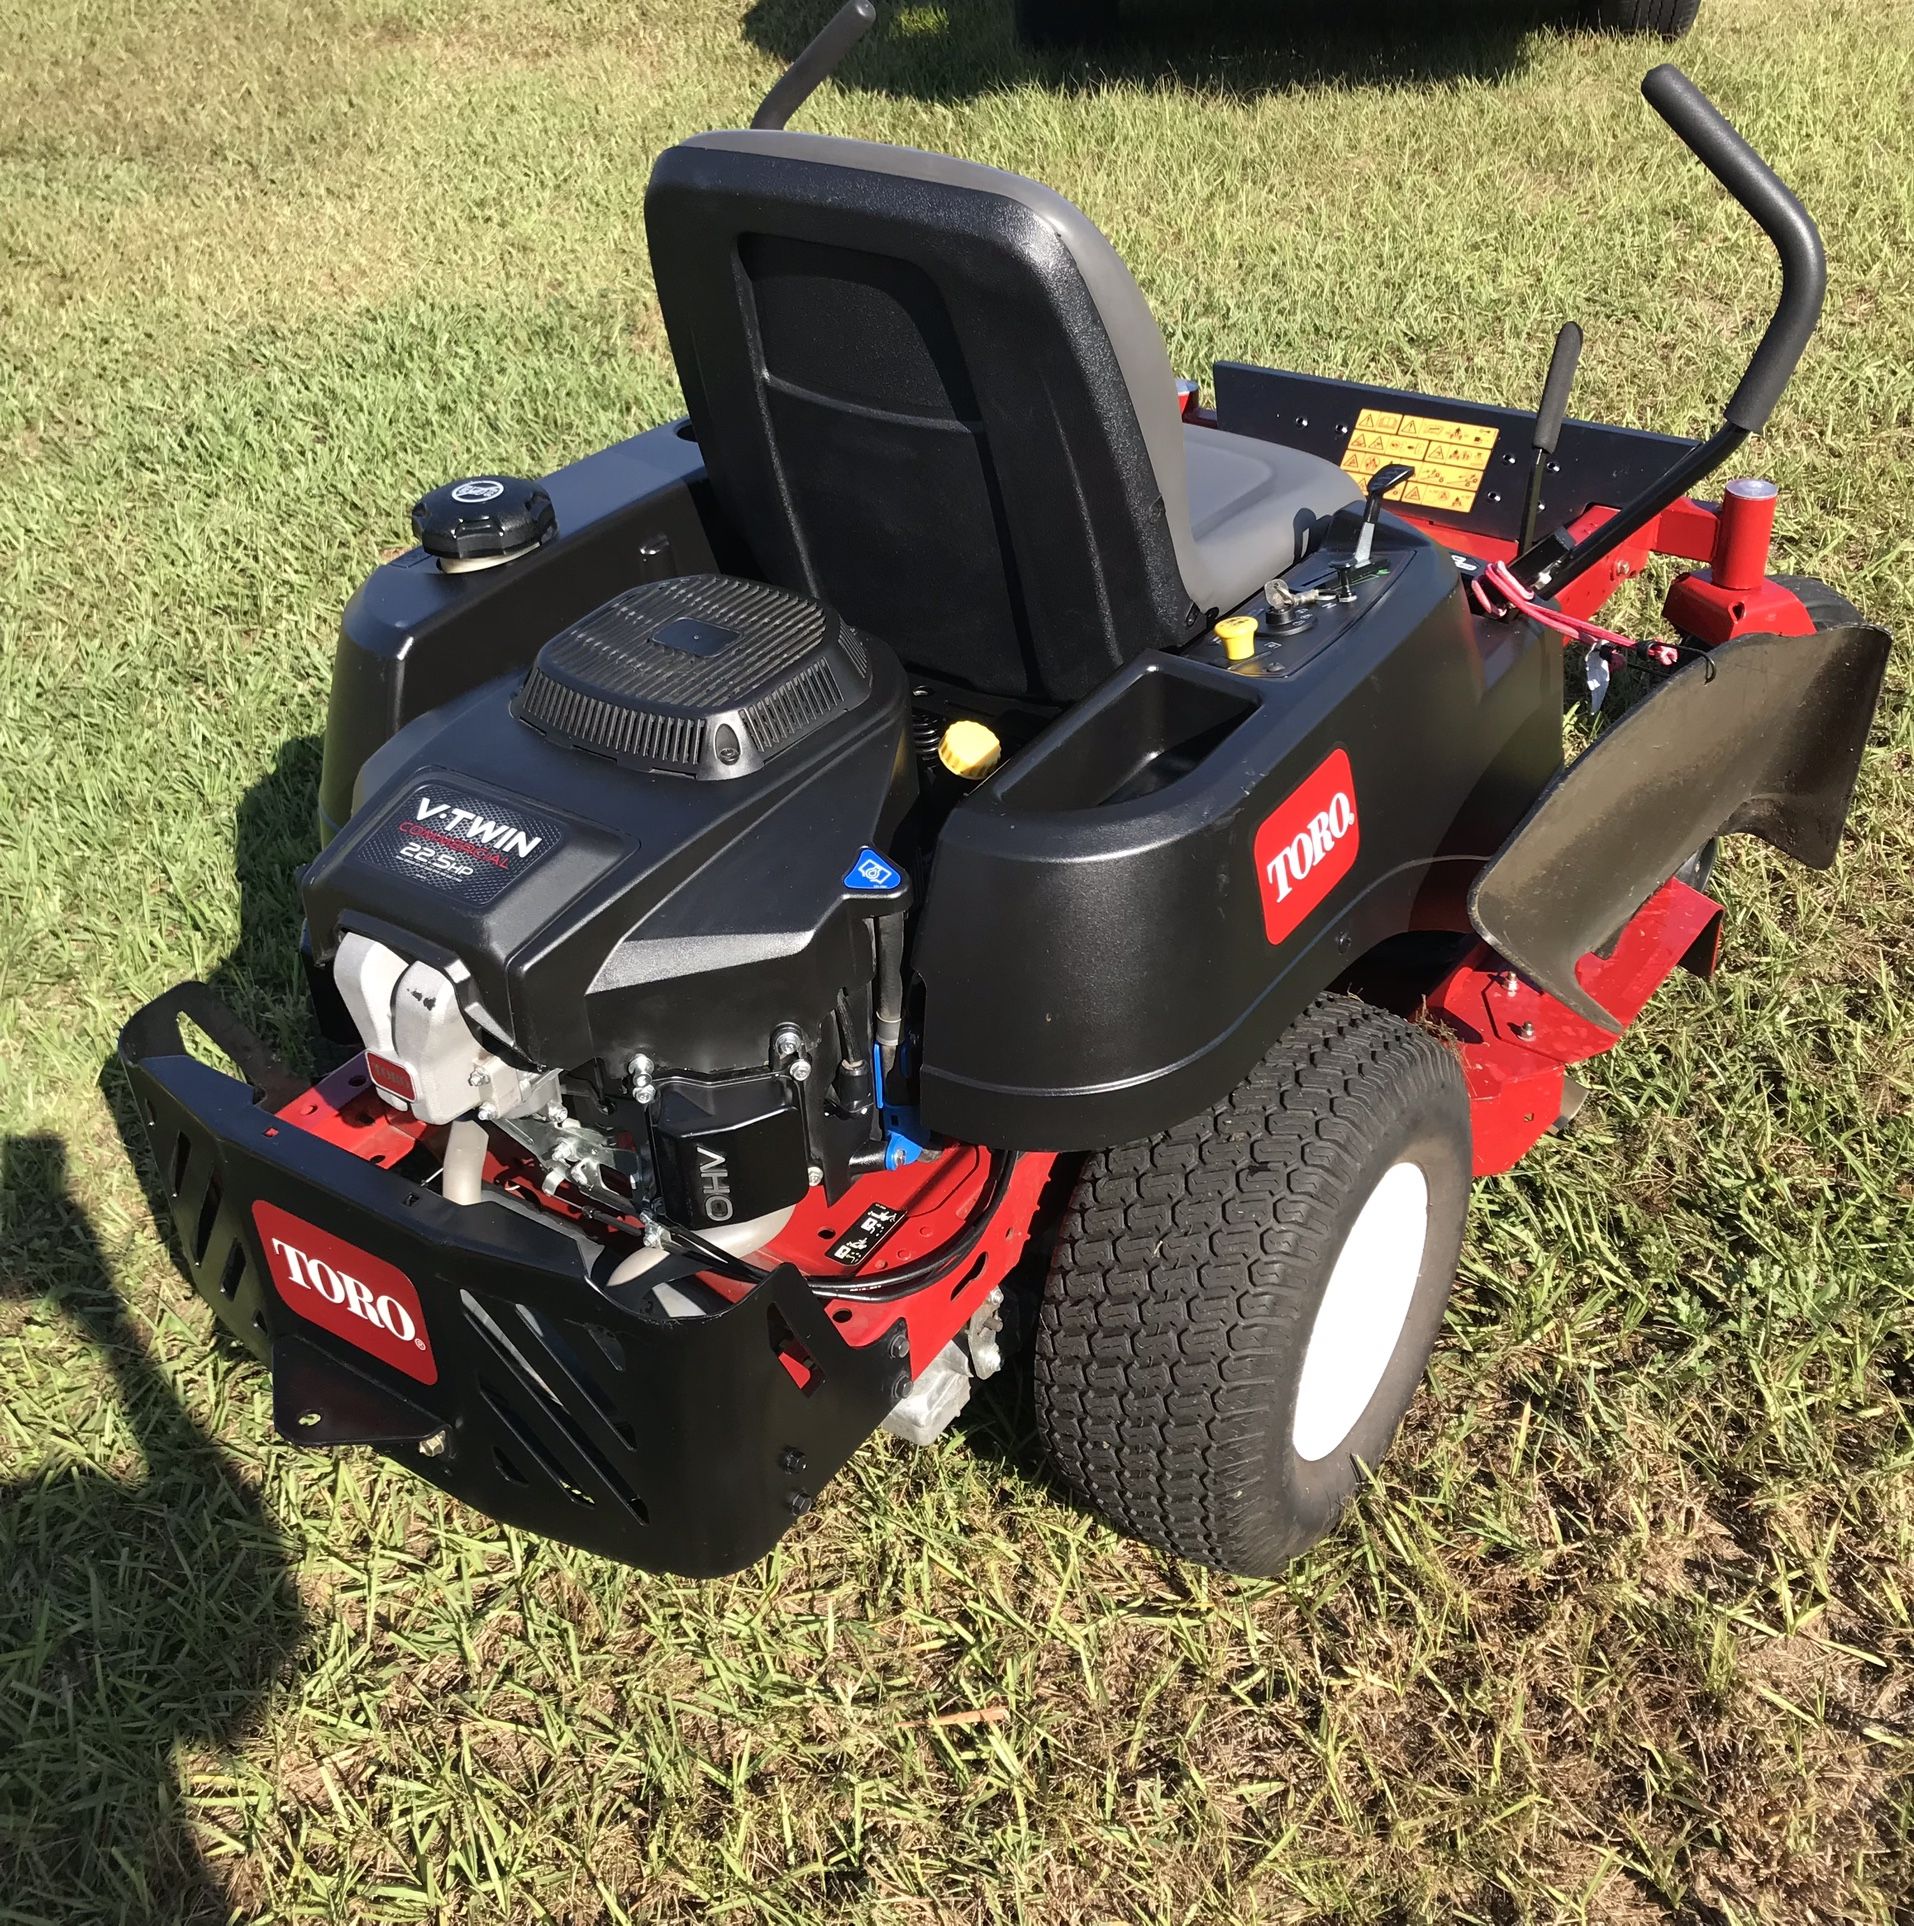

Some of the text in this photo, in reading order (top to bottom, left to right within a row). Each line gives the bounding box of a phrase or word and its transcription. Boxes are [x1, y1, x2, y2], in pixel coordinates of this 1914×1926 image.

[399, 821, 508, 869] COMMERCIAL
[1266, 792, 1351, 903] TORO
[697, 1146, 734, 1222] OHV
[272, 1237, 416, 1342] TORO
